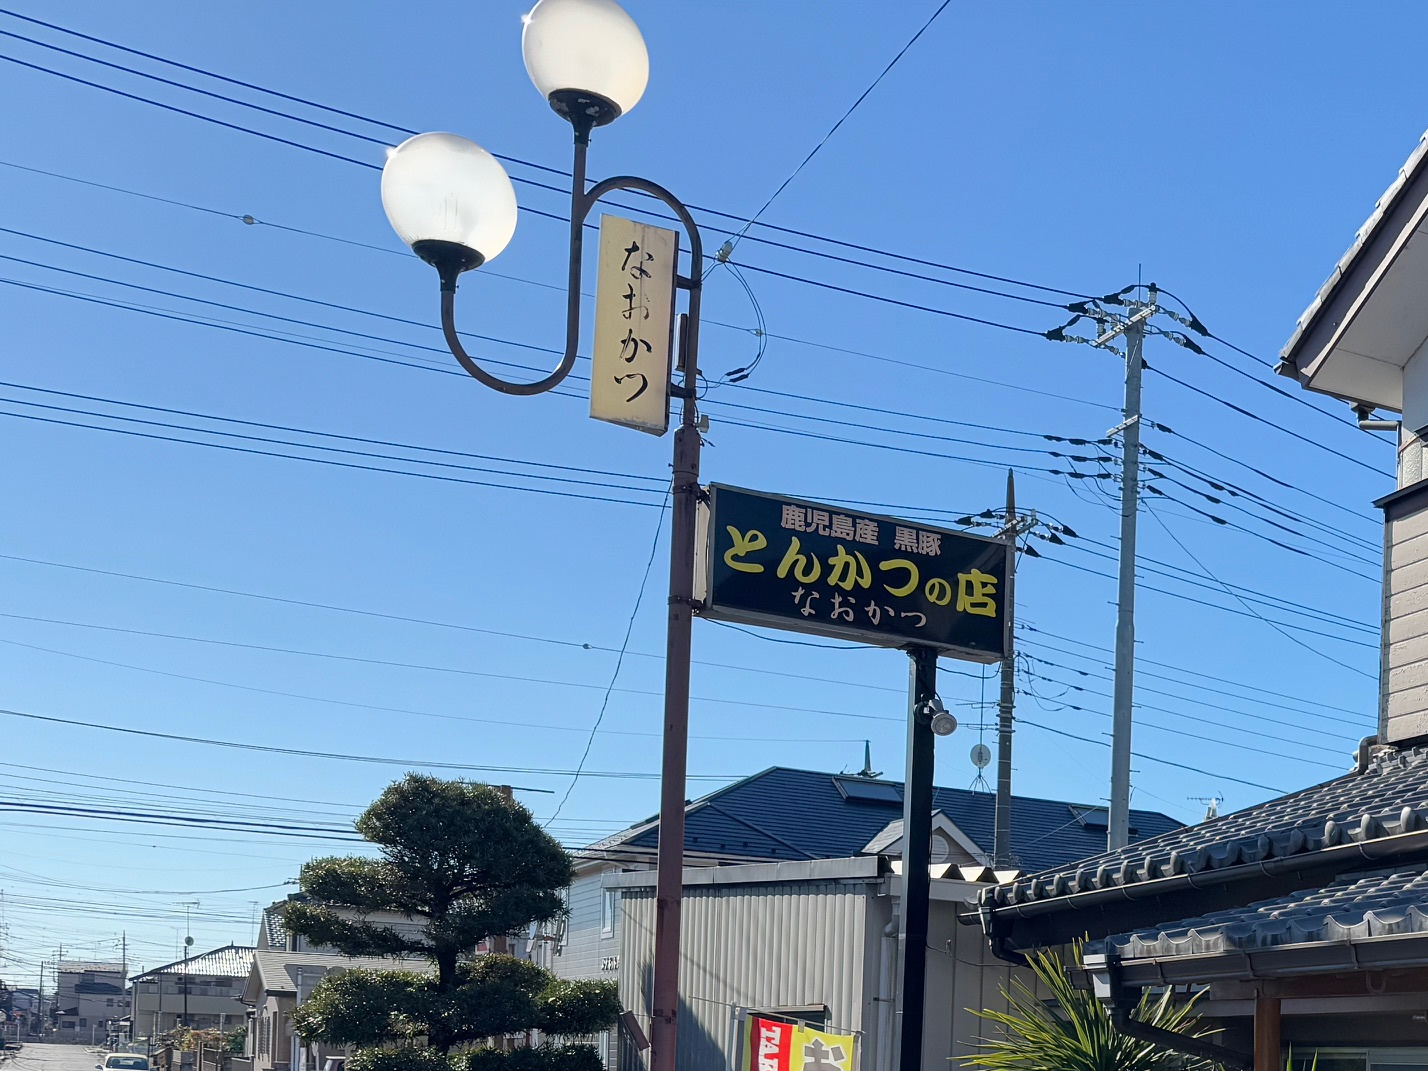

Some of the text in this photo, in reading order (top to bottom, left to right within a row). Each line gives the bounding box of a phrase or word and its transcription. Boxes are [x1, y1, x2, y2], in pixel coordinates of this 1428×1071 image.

[613, 241, 654, 402] なおかつ
[781, 504, 942, 557] 鹿児島産 黒豚
[723, 525, 998, 618] とんかつの店
[791, 586, 927, 628] なおかつ
